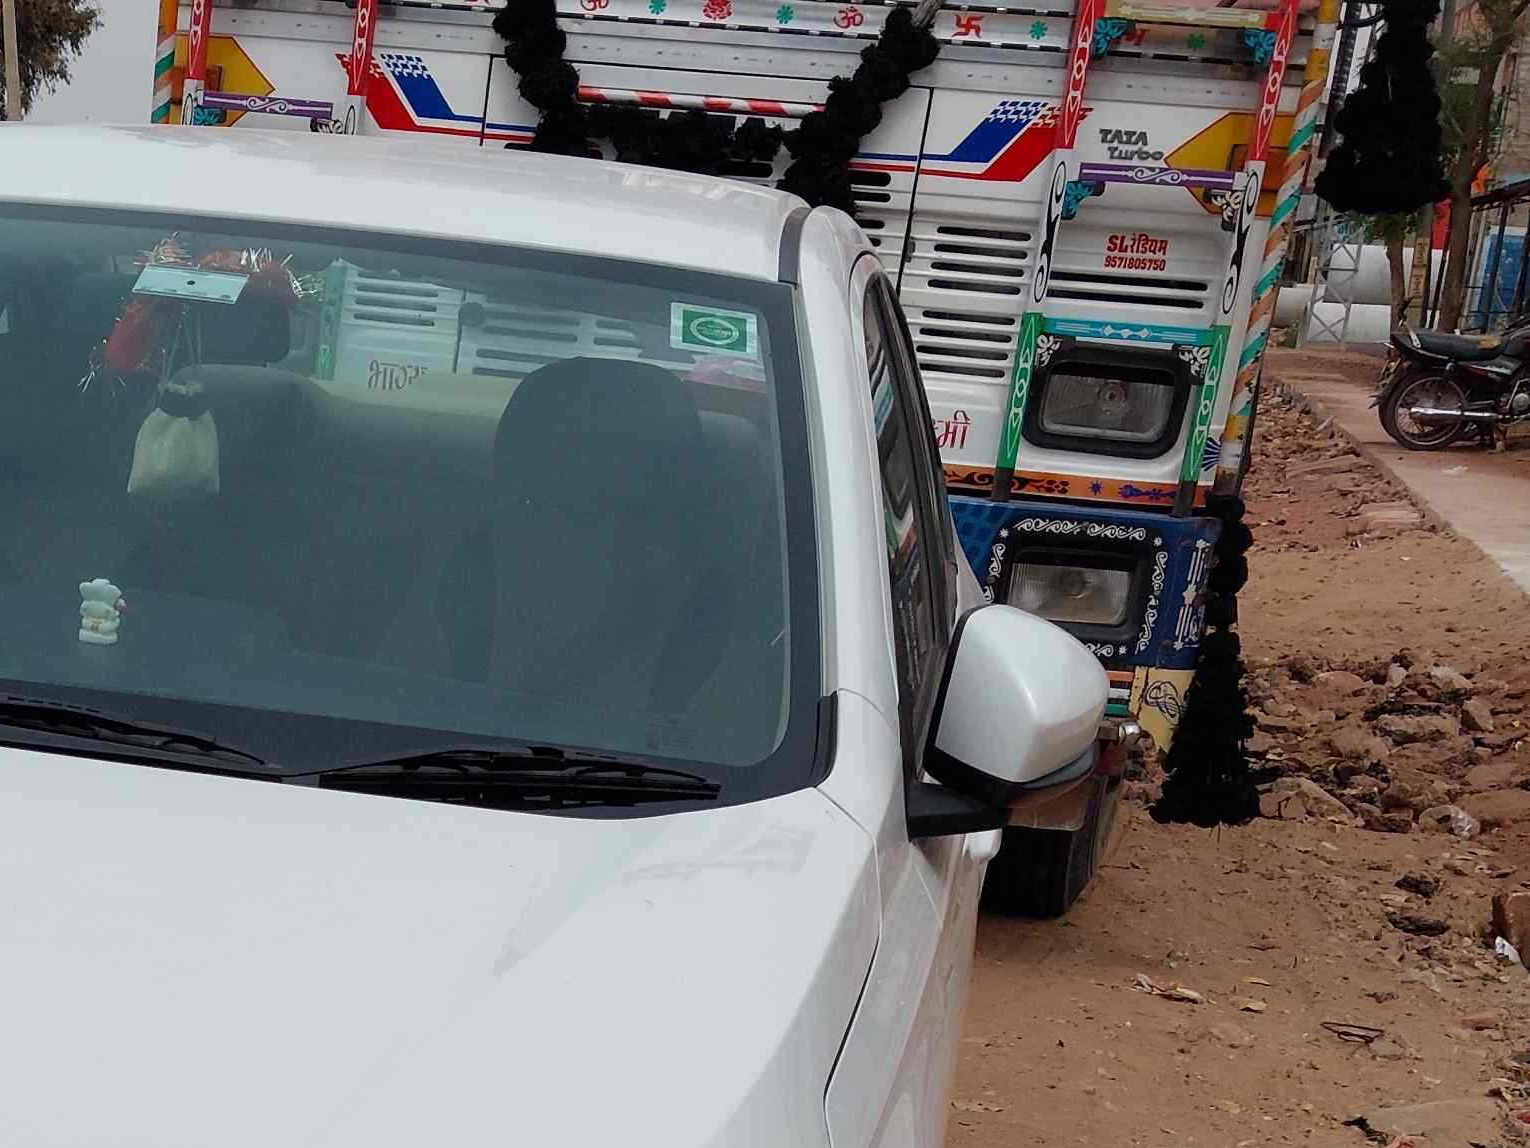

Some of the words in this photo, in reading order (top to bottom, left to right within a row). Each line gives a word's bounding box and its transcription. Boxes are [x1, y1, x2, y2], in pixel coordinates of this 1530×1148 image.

[1099, 128, 1148, 146] TATA
[1108, 146, 1164, 161] Turbo
[1104, 256, 1166, 271] 9571805750
